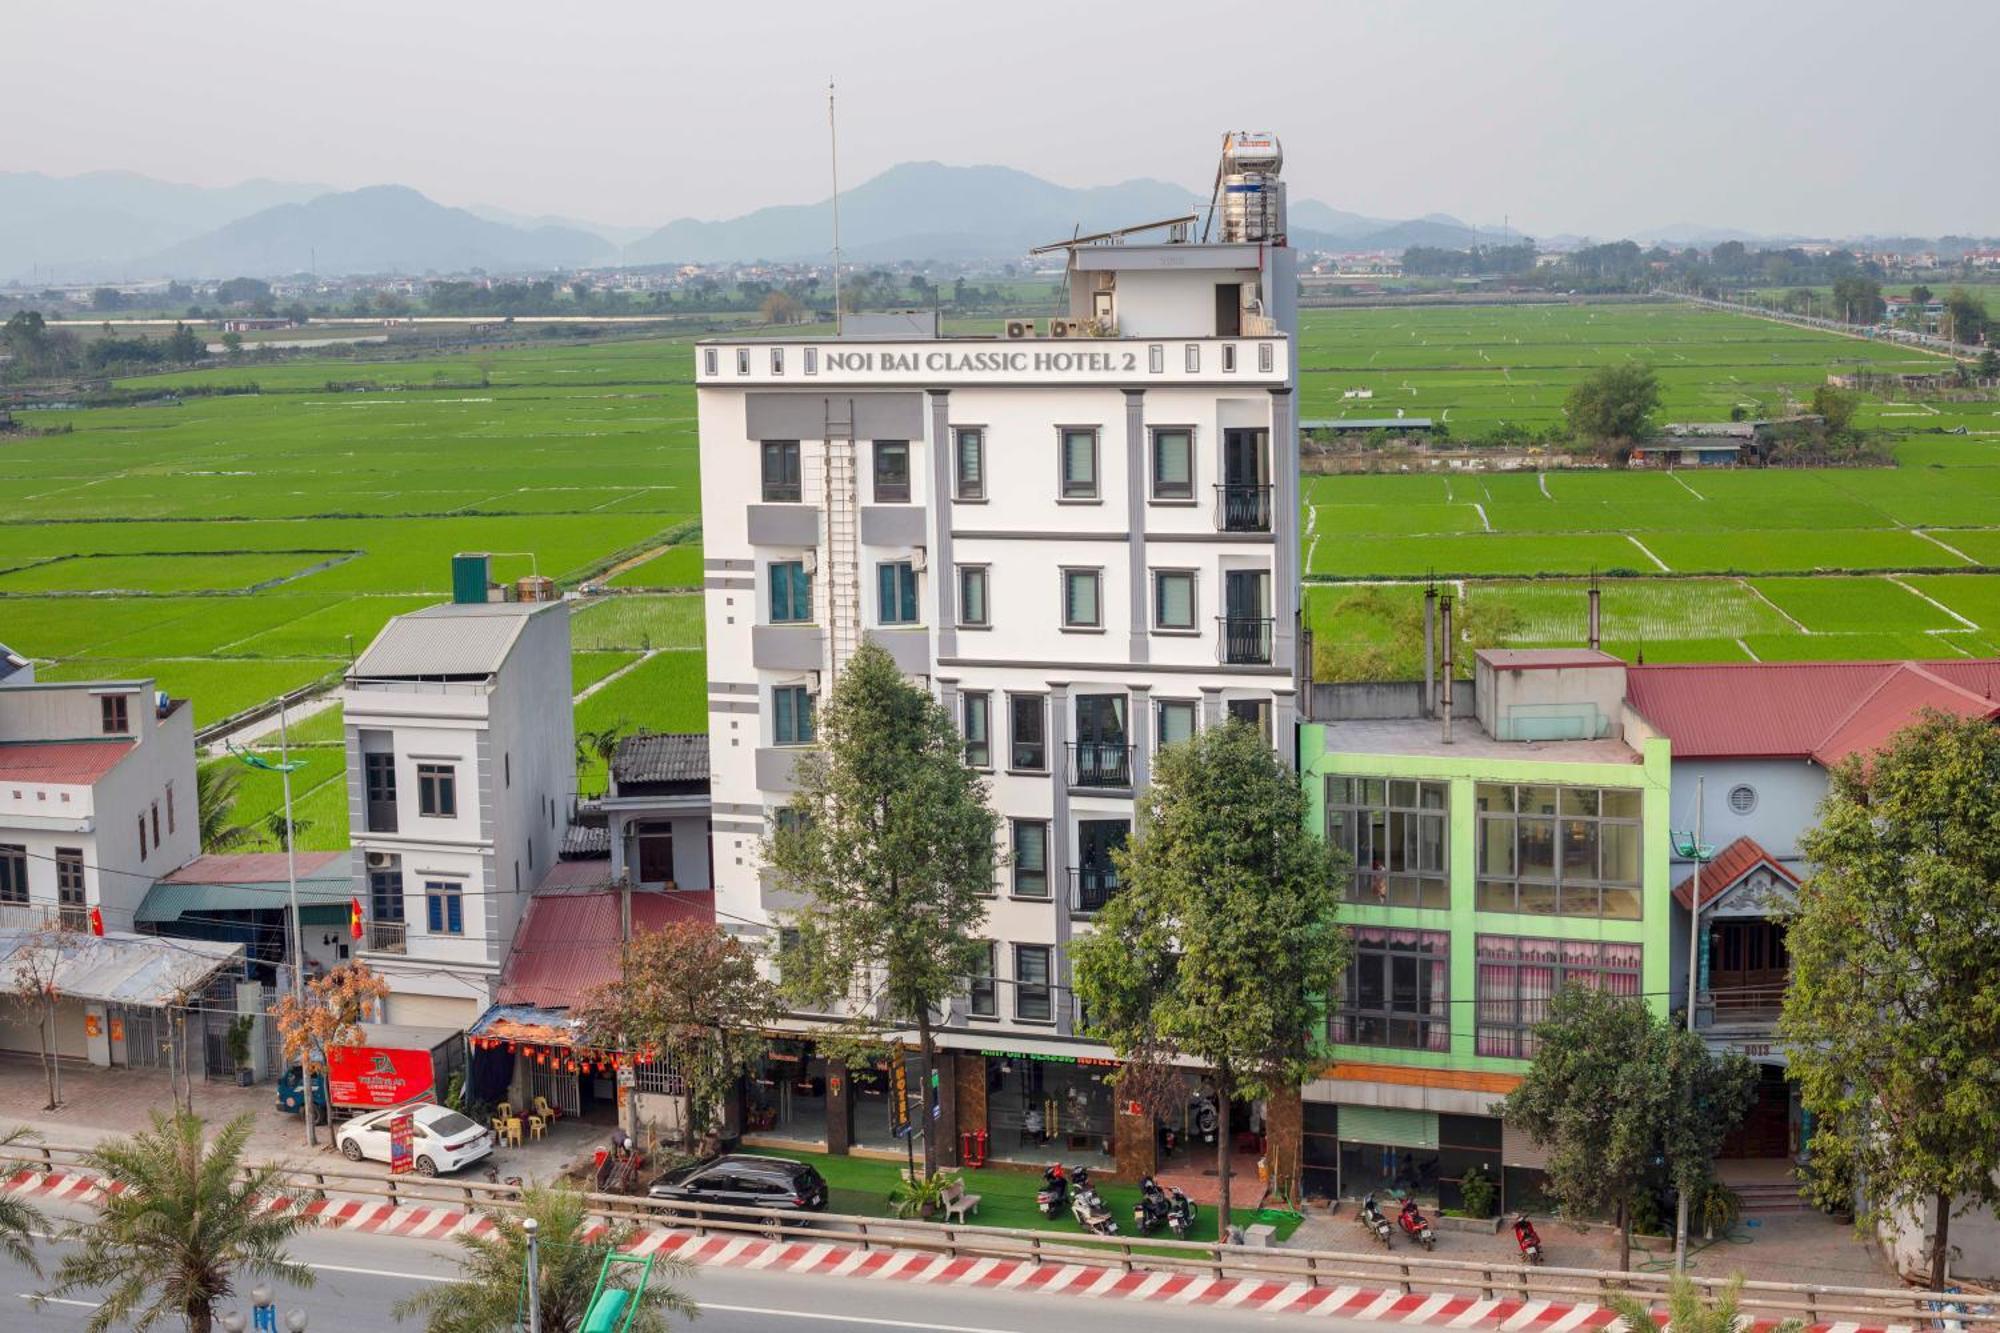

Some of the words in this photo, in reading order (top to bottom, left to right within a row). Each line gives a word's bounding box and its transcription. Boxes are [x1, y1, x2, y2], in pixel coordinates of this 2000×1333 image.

[826, 352, 873, 371] NOI
[880, 352, 919, 371] BAI
[926, 352, 1028, 371] CLASSIC
[1034, 352, 1117, 371] HOTEL
[1121, 352, 1137, 371] 2
